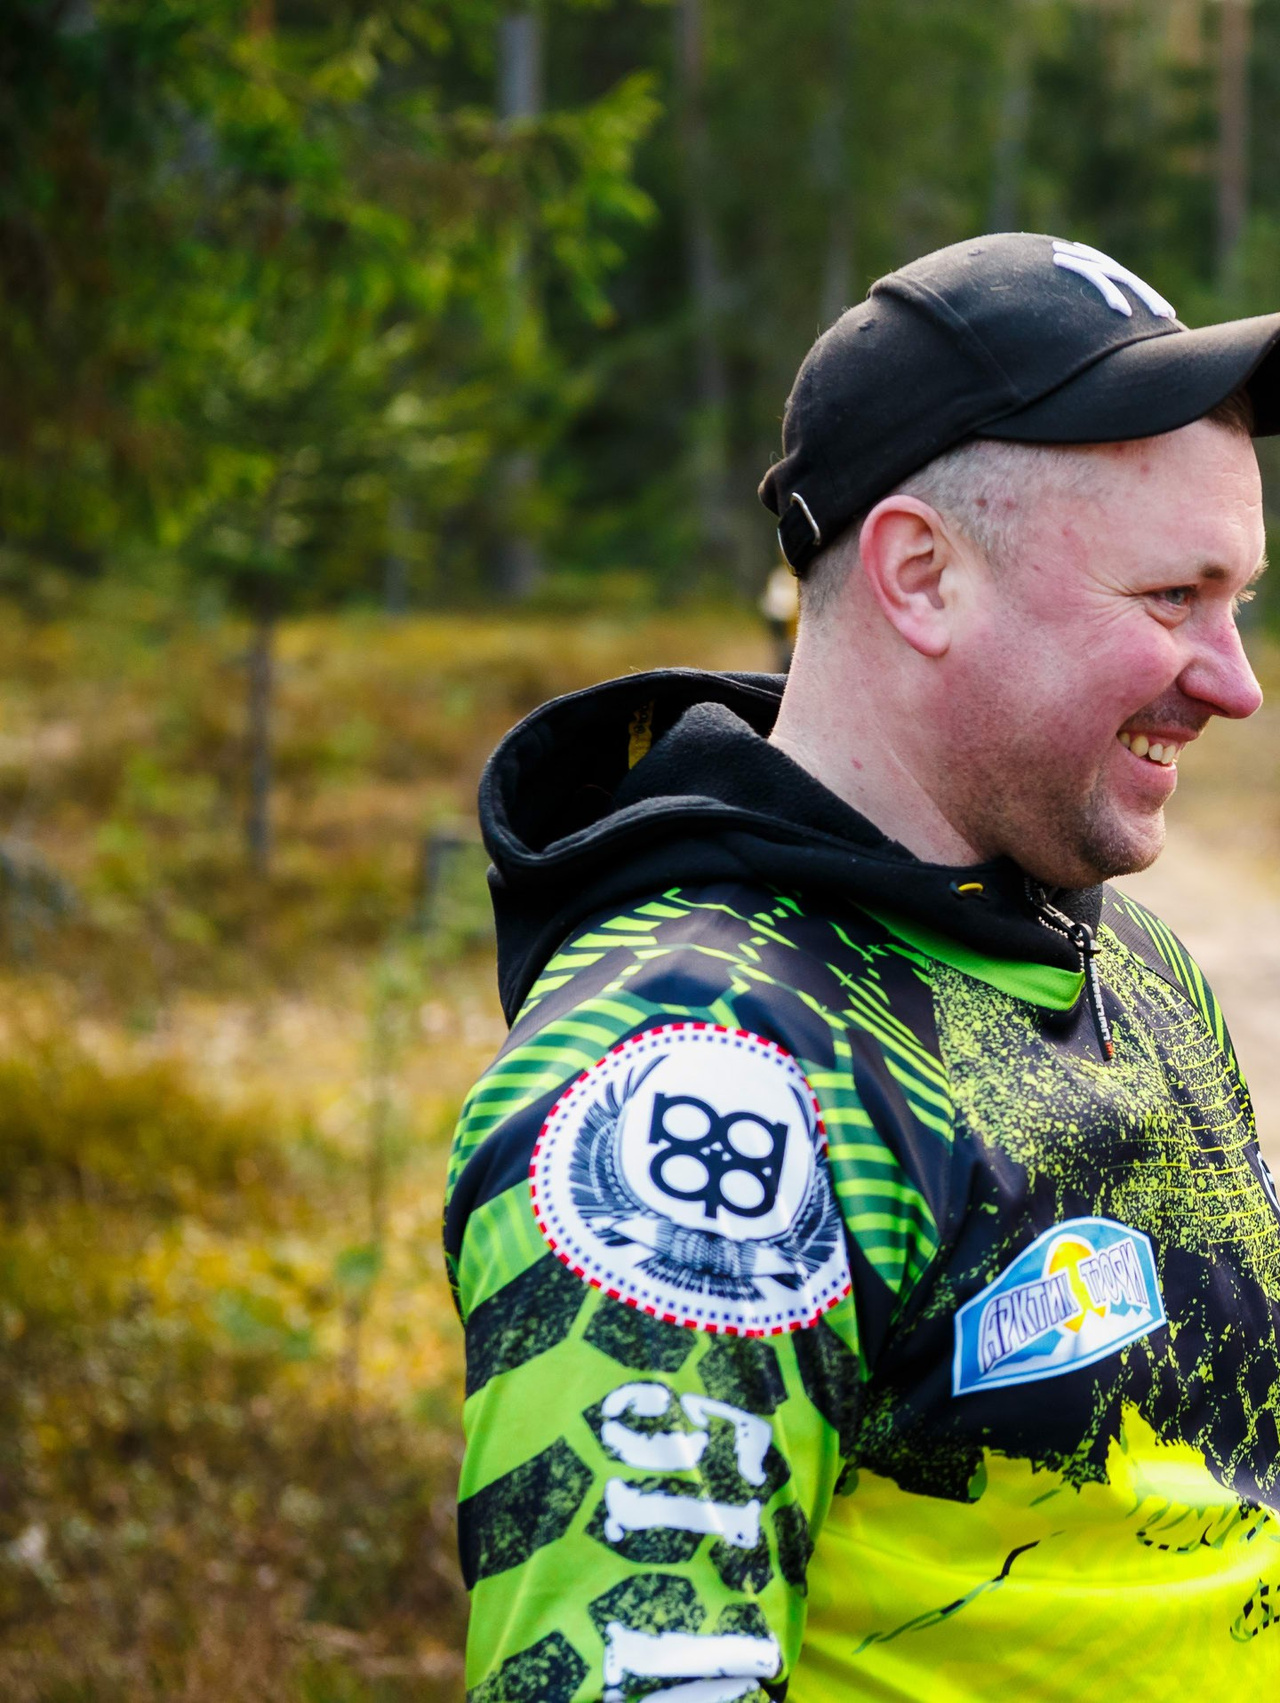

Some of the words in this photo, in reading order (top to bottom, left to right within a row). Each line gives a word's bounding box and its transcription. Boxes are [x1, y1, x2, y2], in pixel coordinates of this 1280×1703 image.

[981, 1271, 1080, 1375] АРКТИК
[1078, 1241, 1148, 1306] ТРОФИ
[601, 1381, 773, 1549] 51
